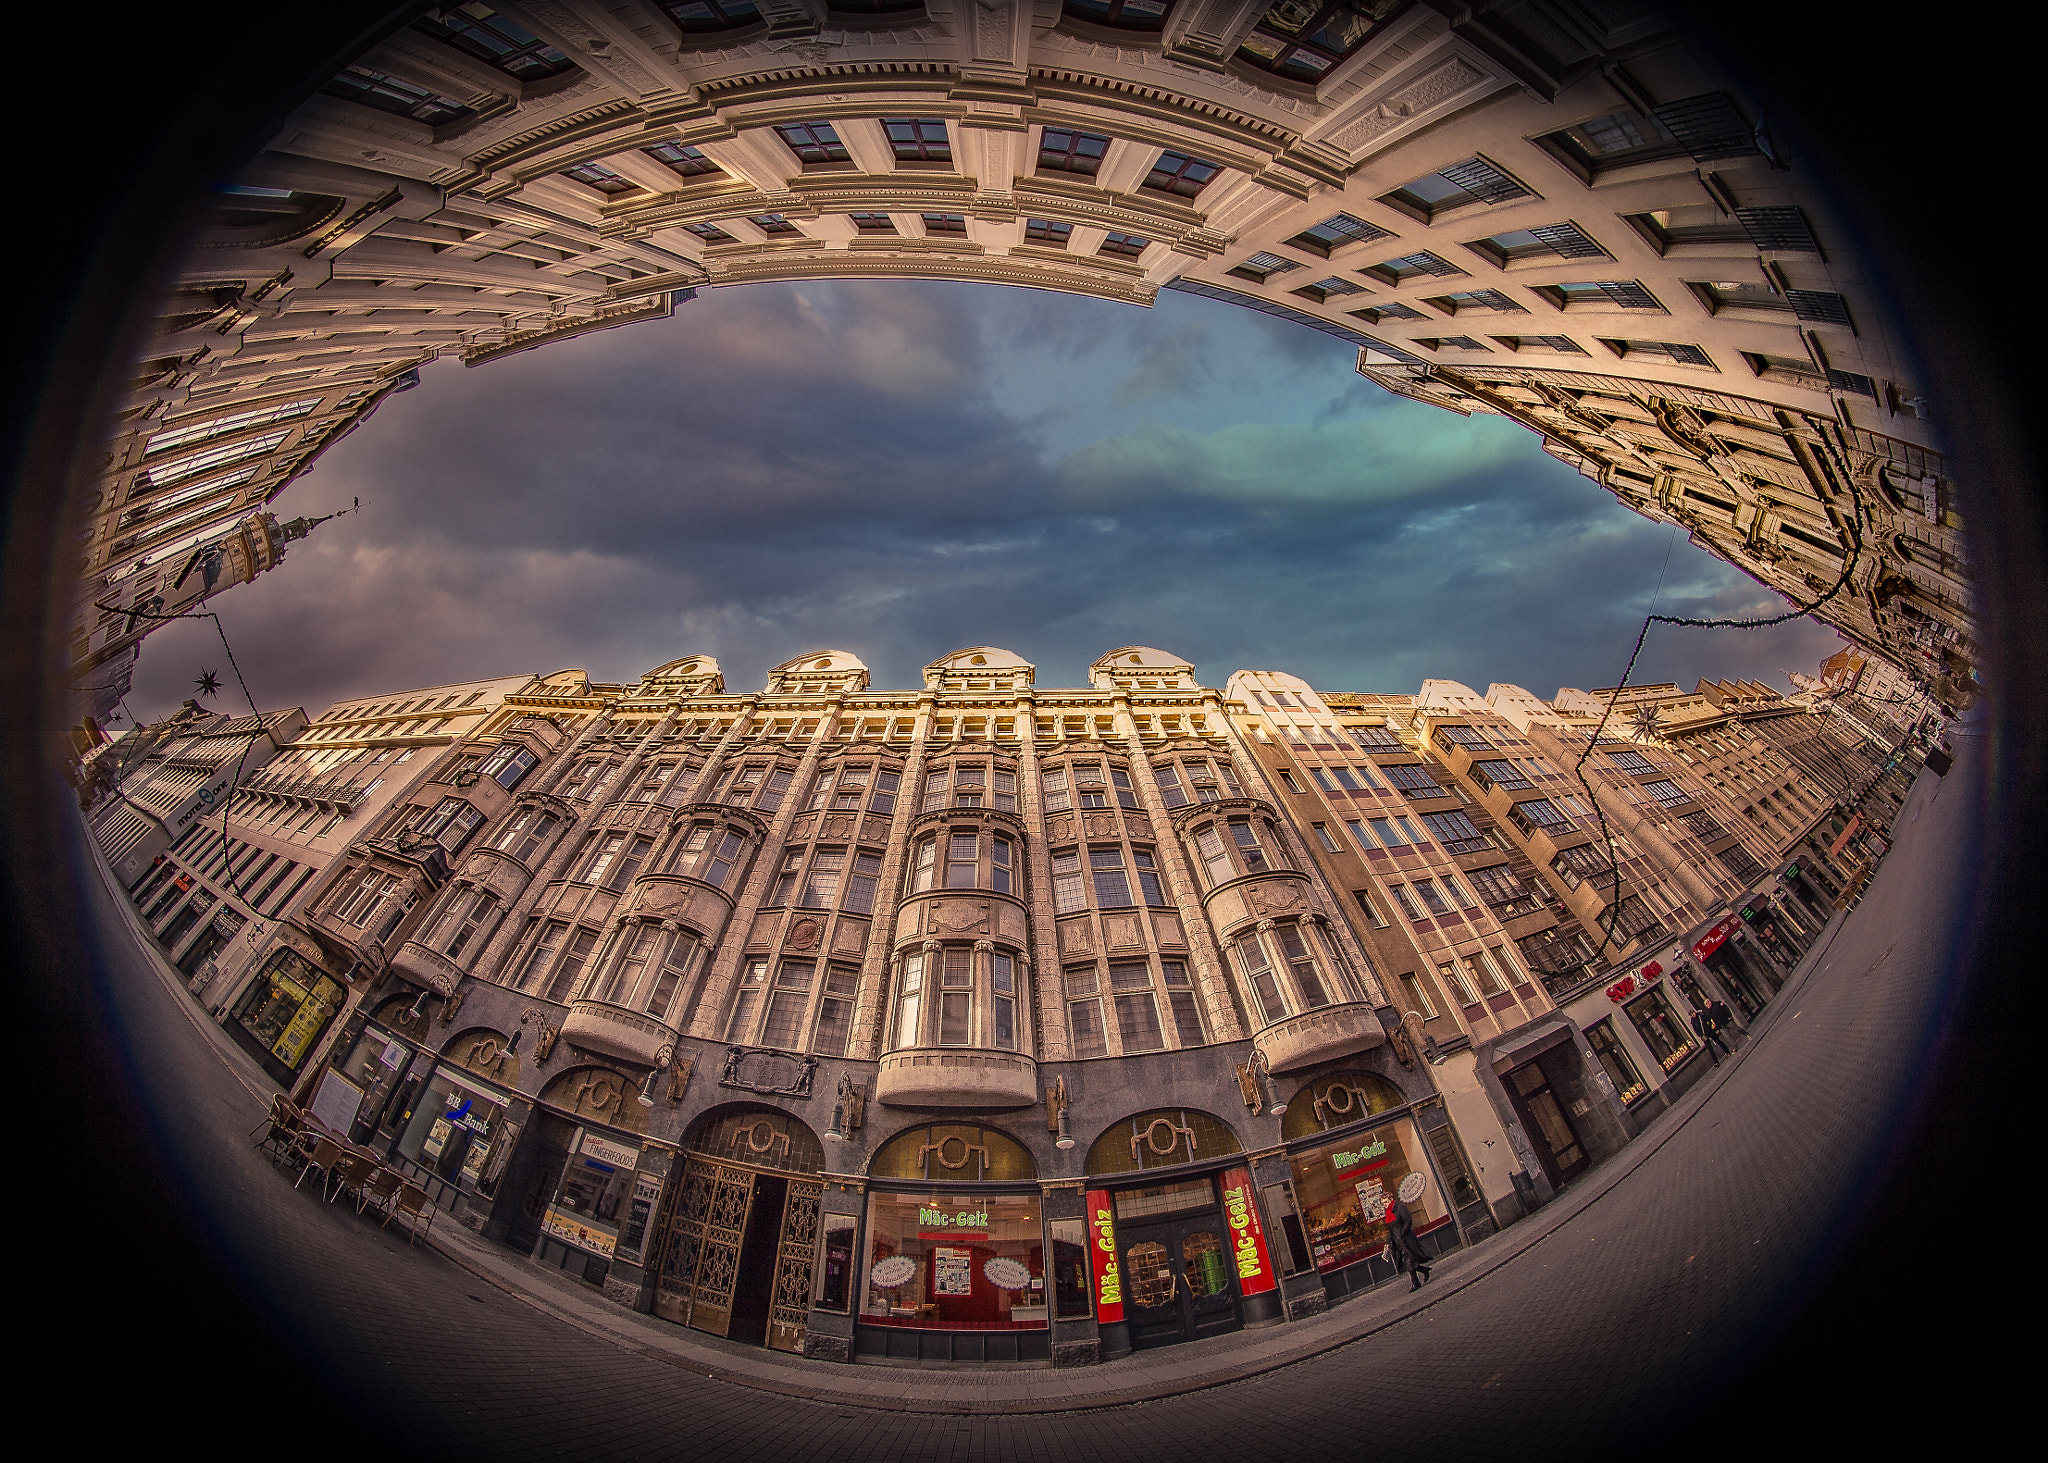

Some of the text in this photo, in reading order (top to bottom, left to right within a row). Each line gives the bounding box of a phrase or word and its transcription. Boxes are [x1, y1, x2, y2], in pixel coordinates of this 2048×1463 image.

[446, 1093, 460, 1109] BB
[464, 1112, 489, 1135] Bank
[589, 1144, 635, 1168] FINGERFOODS
[1333, 1141, 1387, 1169] Mäc-Geiz
[919, 1207, 988, 1227] Mäc-Geiz
[1225, 1186, 1262, 1279] Mäc-Geiz
[1094, 1208, 1122, 1305] Mäc-Geiz
